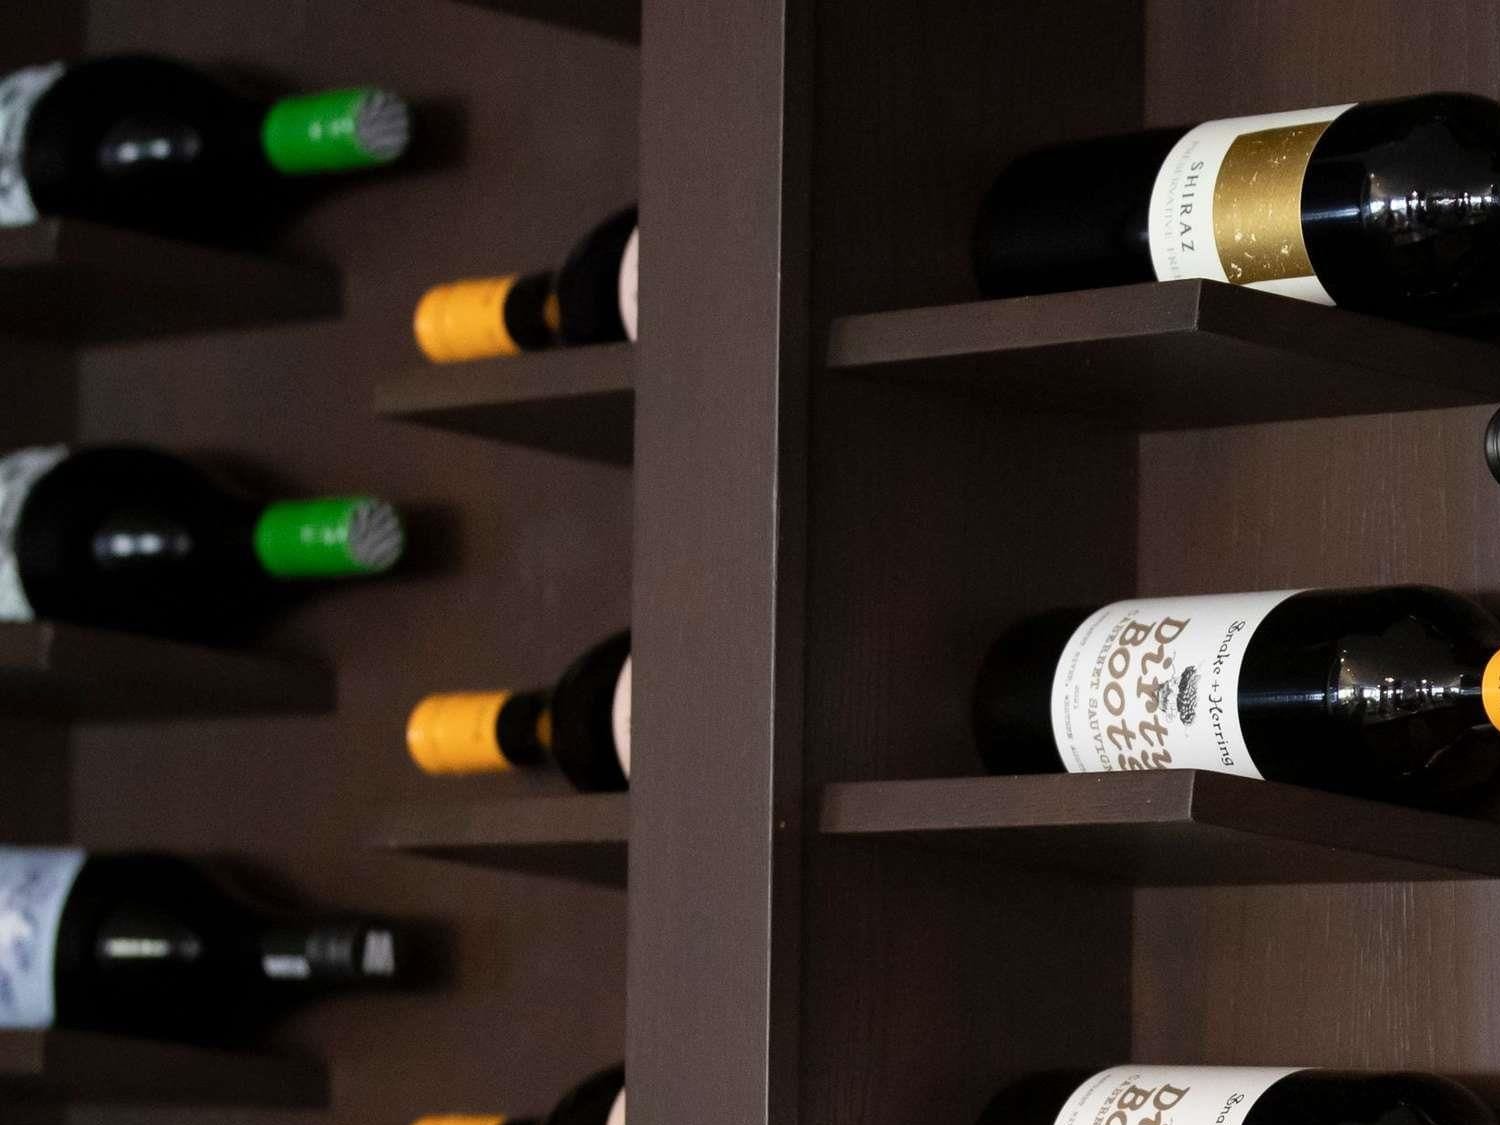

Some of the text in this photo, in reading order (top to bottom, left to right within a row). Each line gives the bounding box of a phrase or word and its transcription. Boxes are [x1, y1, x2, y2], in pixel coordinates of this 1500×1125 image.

[1180, 161, 1204, 254] SHIRAZ
[1211, 621, 1247, 675] Snake
[1136, 616, 1193, 770] Dirty
[1208, 693, 1236, 767] Herring
[1087, 698, 1114, 772] SAUVIGN
